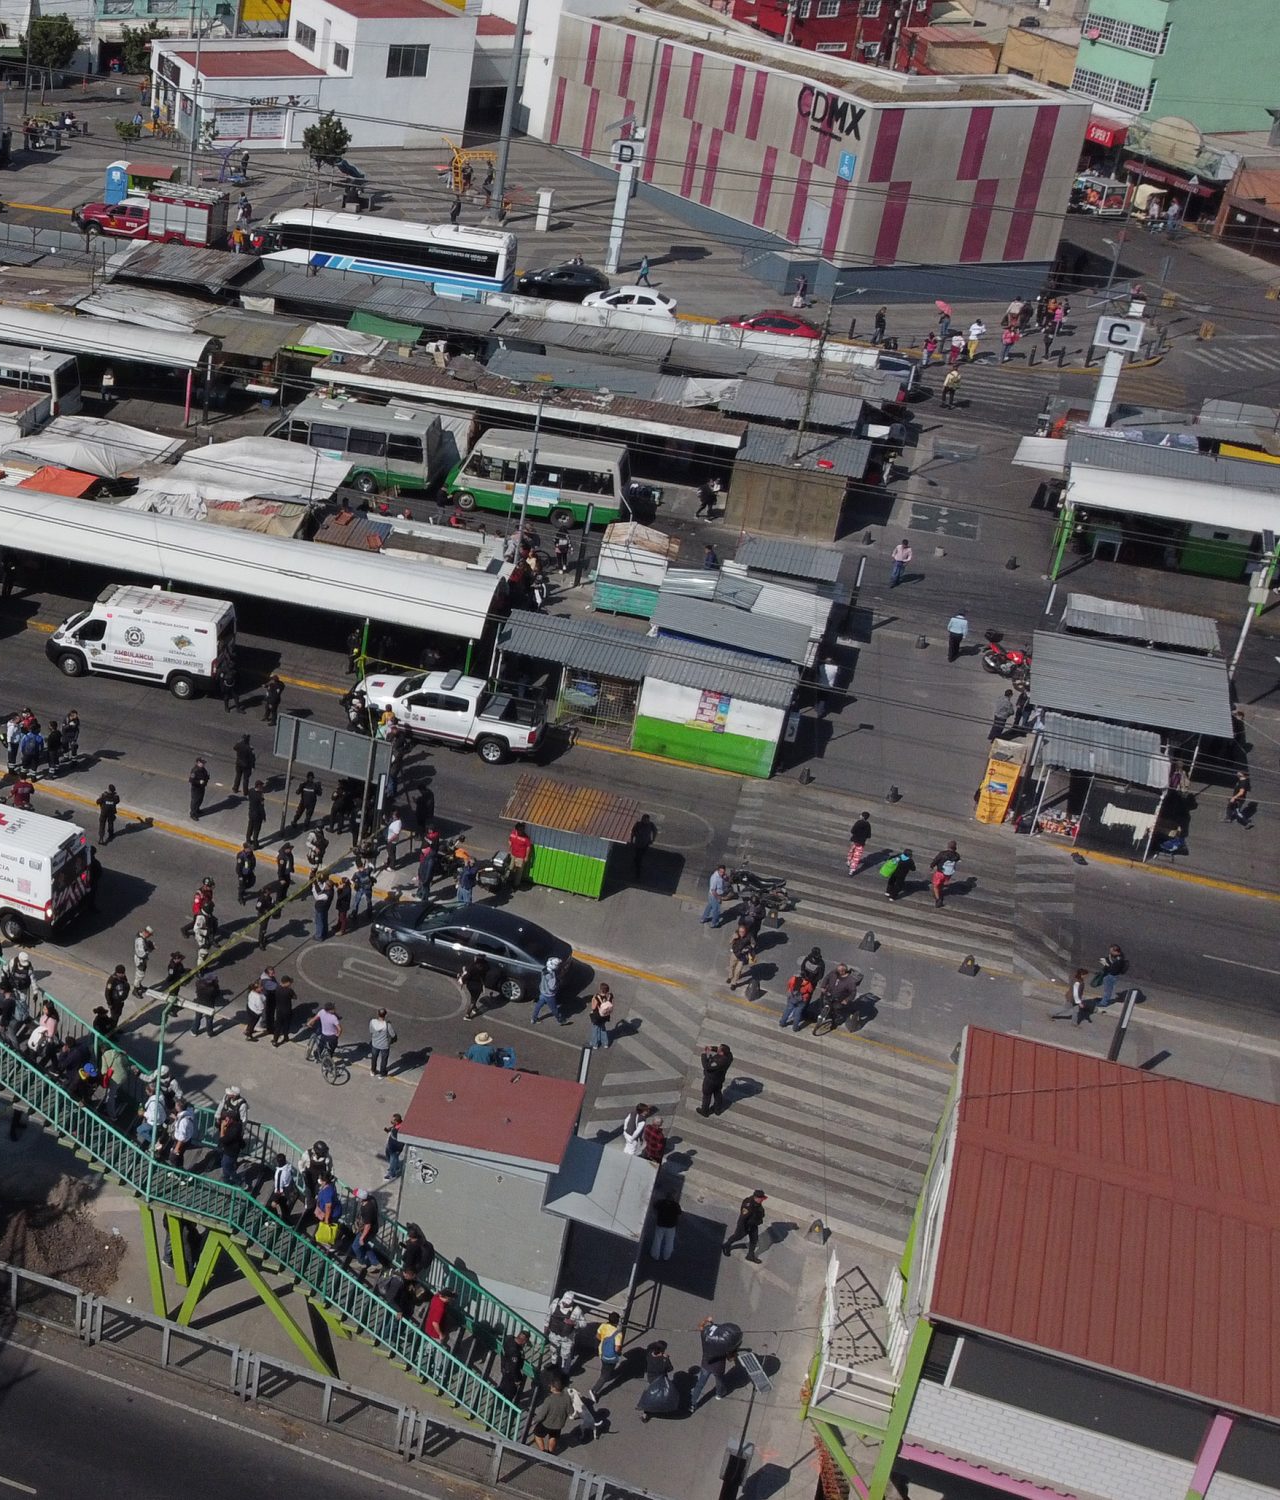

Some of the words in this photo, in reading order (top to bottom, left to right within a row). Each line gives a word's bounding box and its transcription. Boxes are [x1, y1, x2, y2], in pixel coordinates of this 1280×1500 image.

[797, 86, 866, 141] CDMX
[619, 145, 634, 162] D
[1108, 323, 1130, 345] C
[113, 649, 154, 662] AMBULANCIA
